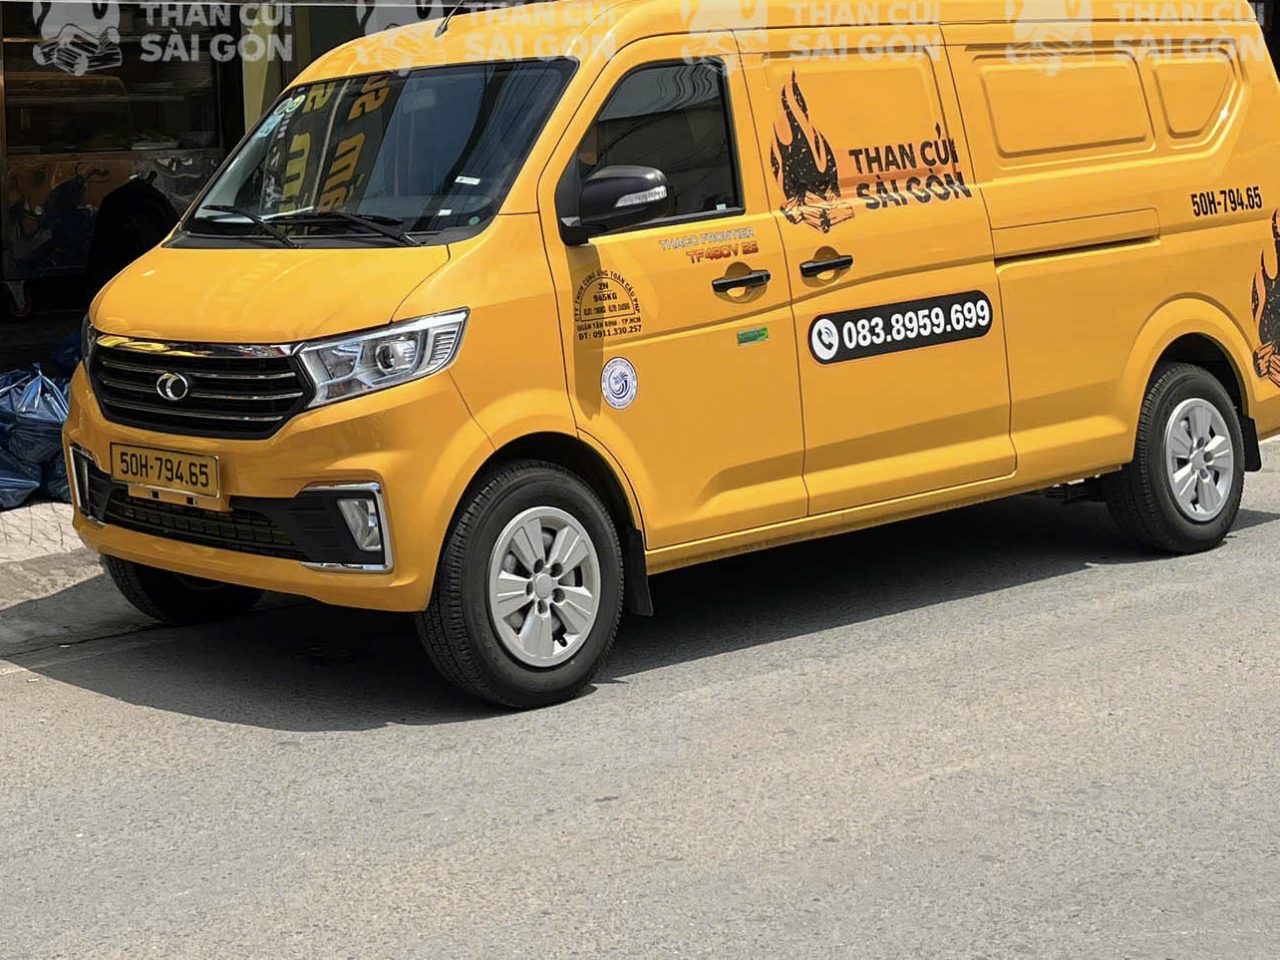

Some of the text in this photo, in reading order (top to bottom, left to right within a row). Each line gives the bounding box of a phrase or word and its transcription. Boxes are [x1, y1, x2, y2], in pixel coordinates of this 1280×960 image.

[849, 141, 918, 176] THAN
[855, 167, 972, 210] SÀI GÒN
[1190, 185, 1263, 218] 50H-794.65
[842, 299, 990, 350] 083.8959.699
[119, 454, 210, 489] 50H-794.65
